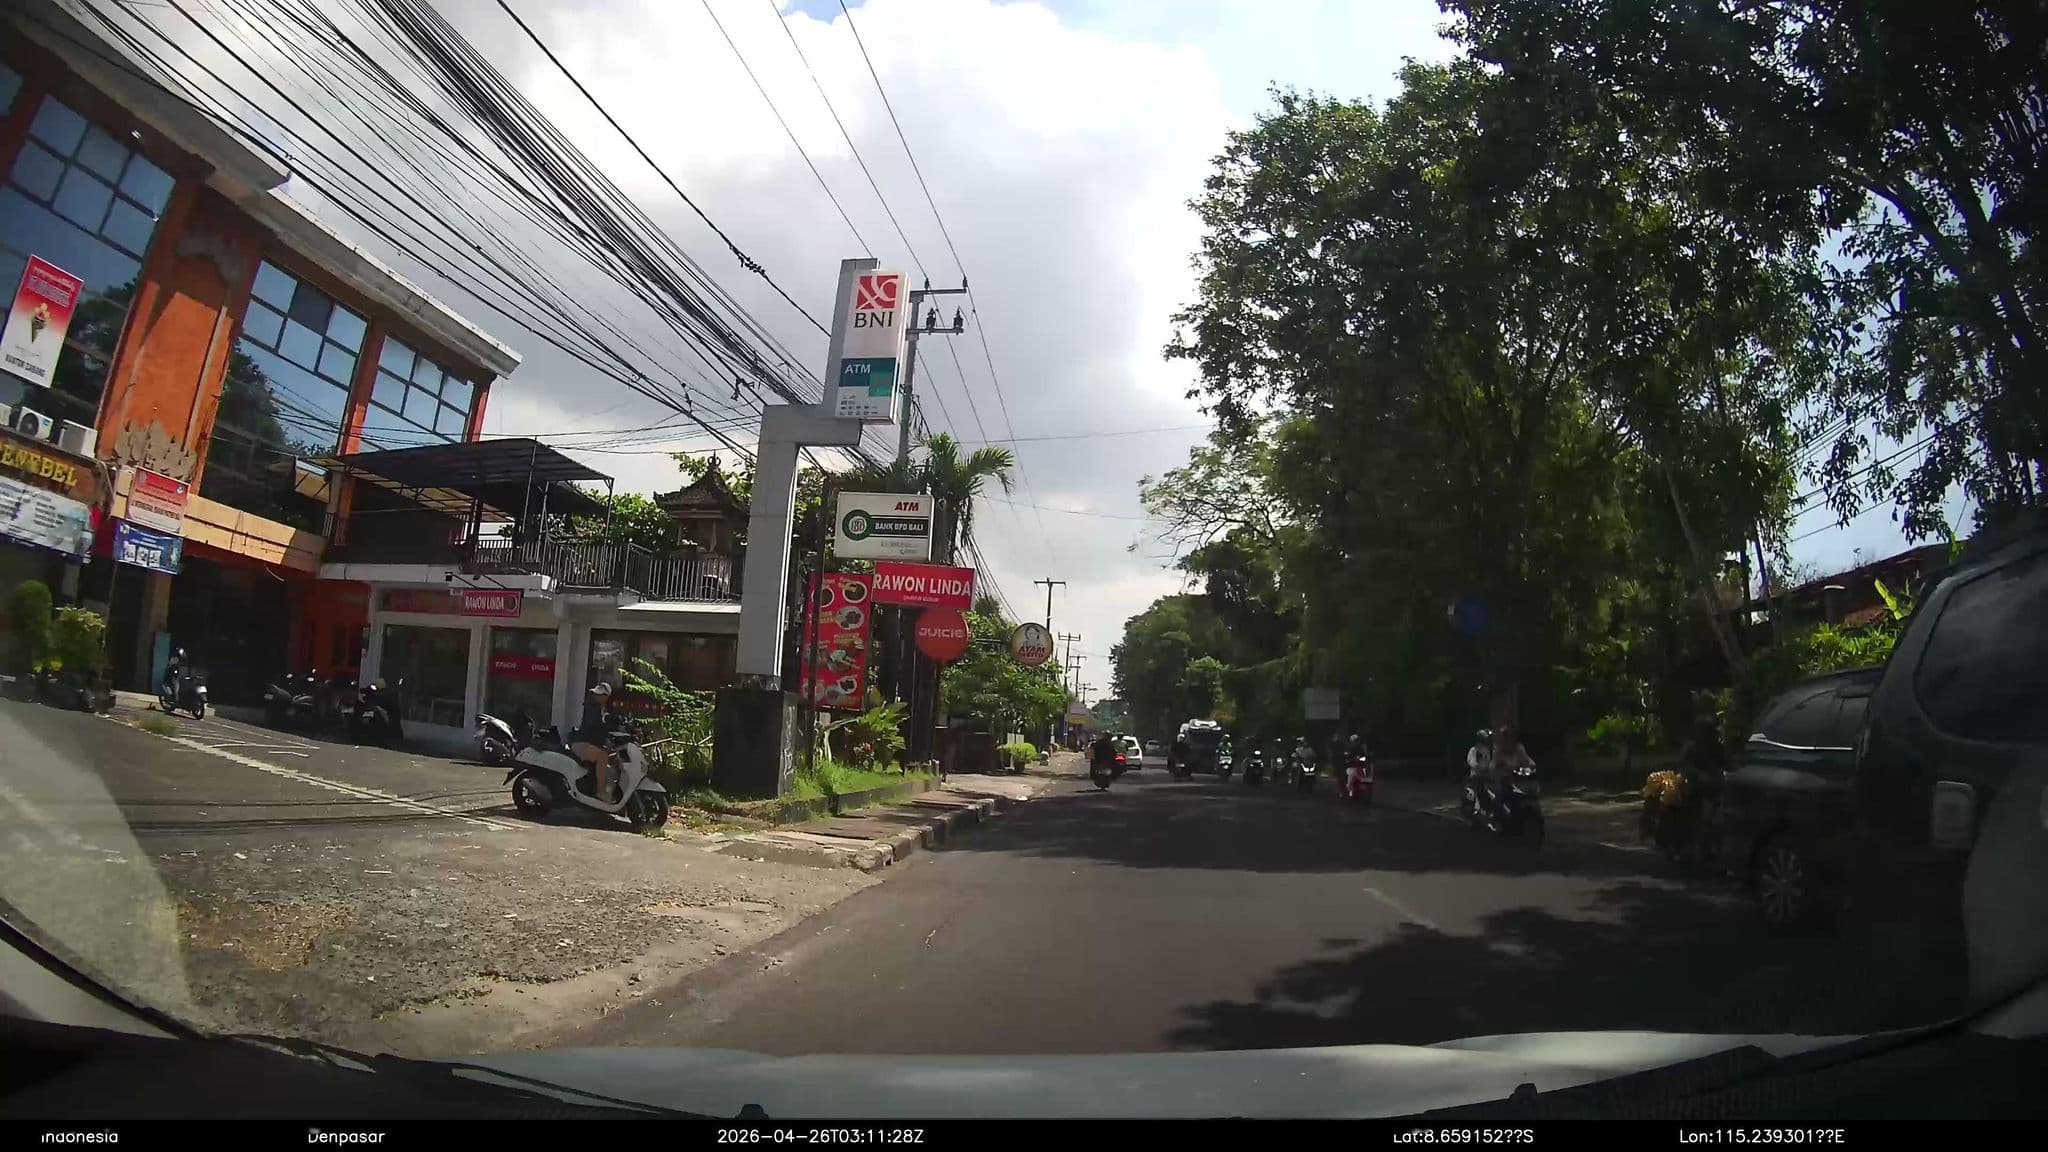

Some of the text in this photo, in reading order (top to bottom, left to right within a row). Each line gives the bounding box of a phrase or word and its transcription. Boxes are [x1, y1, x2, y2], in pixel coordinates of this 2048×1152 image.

[854, 311, 894, 329] BNI
[844, 363, 872, 375] ATM
[894, 501, 920, 512] ATM
[874, 522, 893, 531] BANK
[908, 522, 924, 531] BALI
[873, 573, 926, 593] RAWON
[929, 578, 971, 597] LINDA
